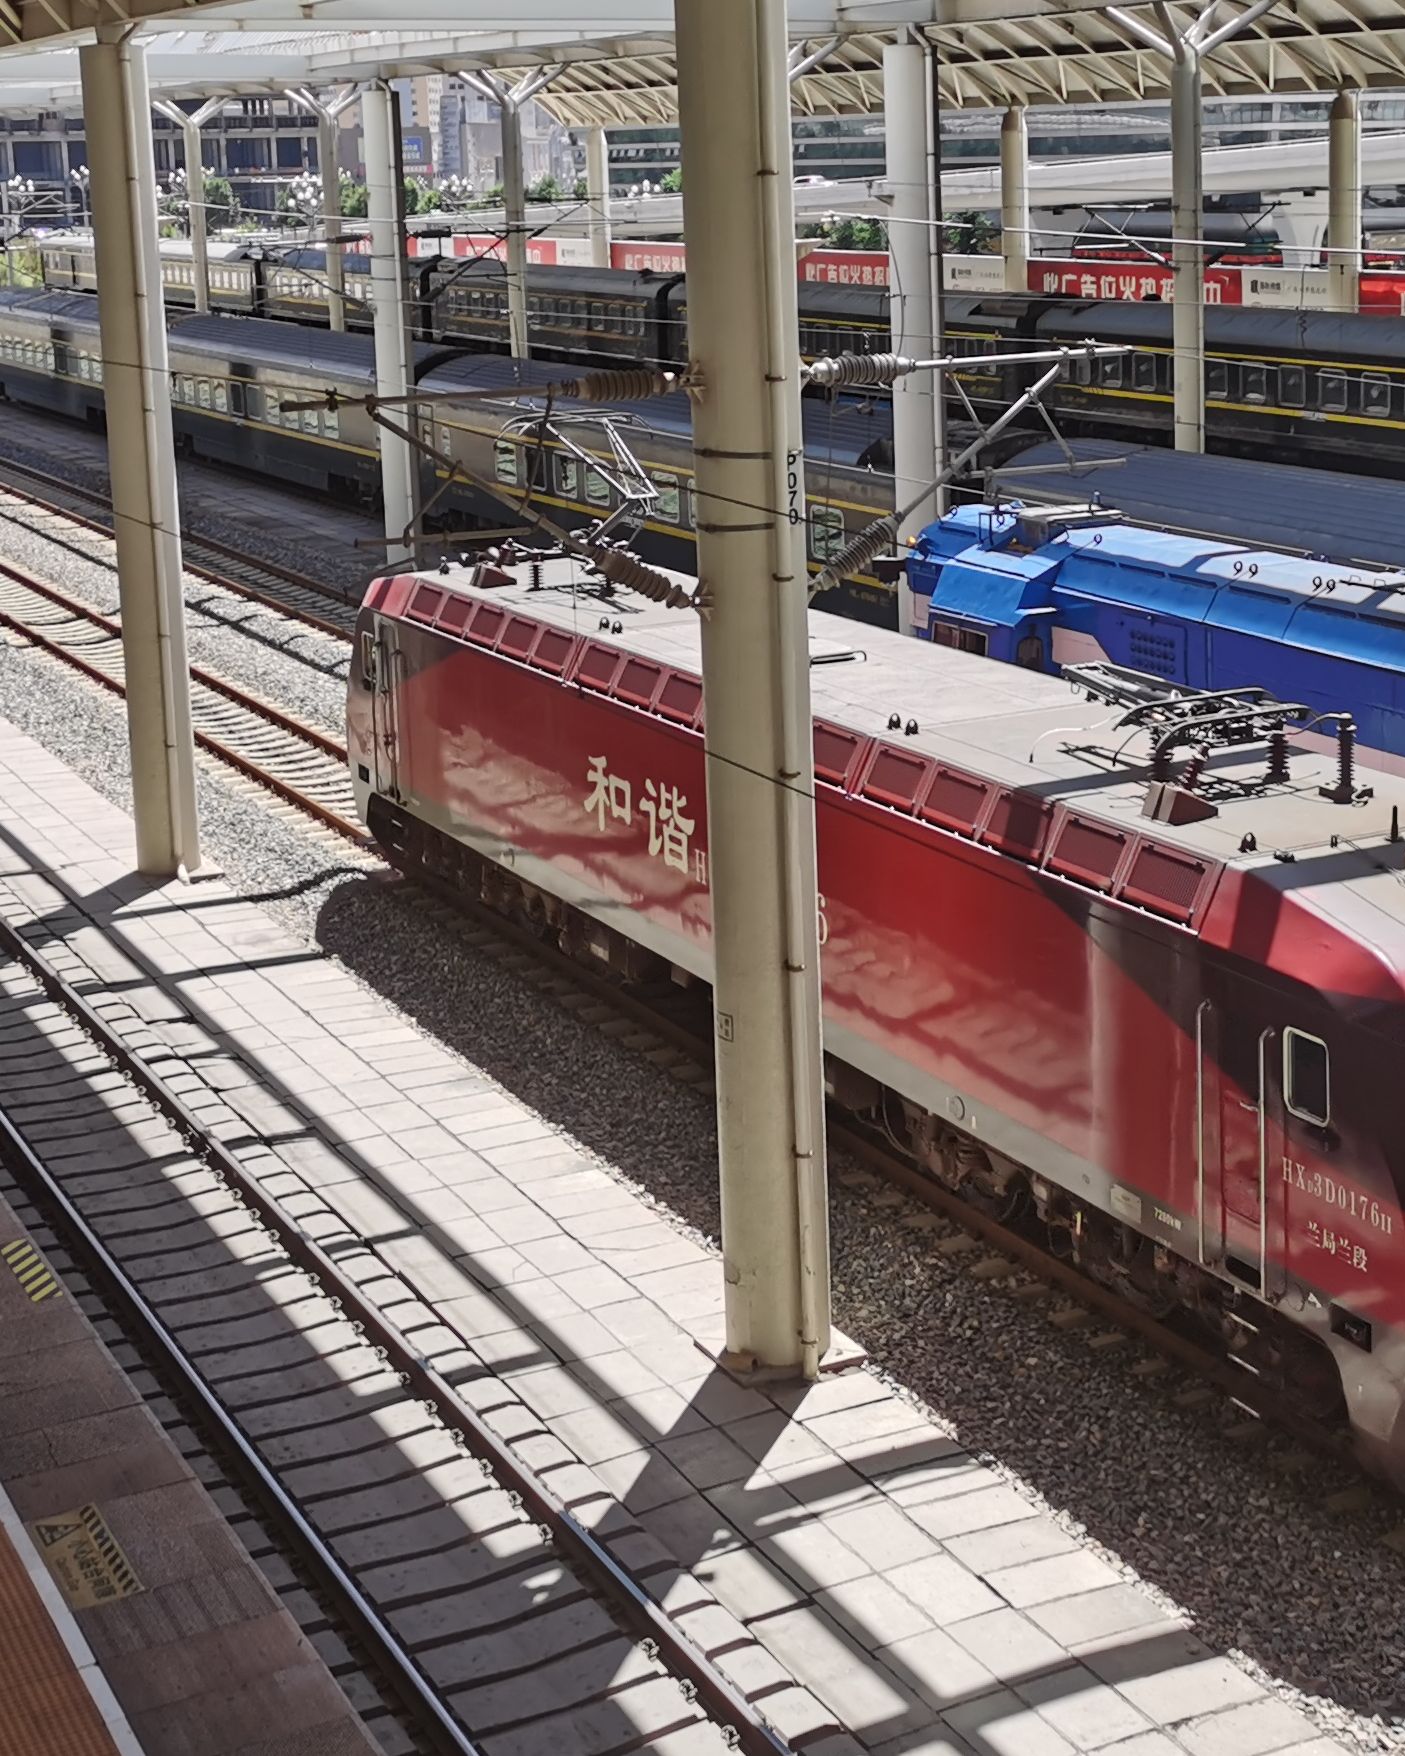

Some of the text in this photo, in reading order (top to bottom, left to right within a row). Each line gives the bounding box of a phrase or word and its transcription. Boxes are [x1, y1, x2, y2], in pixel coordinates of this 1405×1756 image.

[787, 453, 799, 525] P070
[584, 755, 695, 874] 和谐
[1306, 1220, 1368, 1273] 兰局兰段
